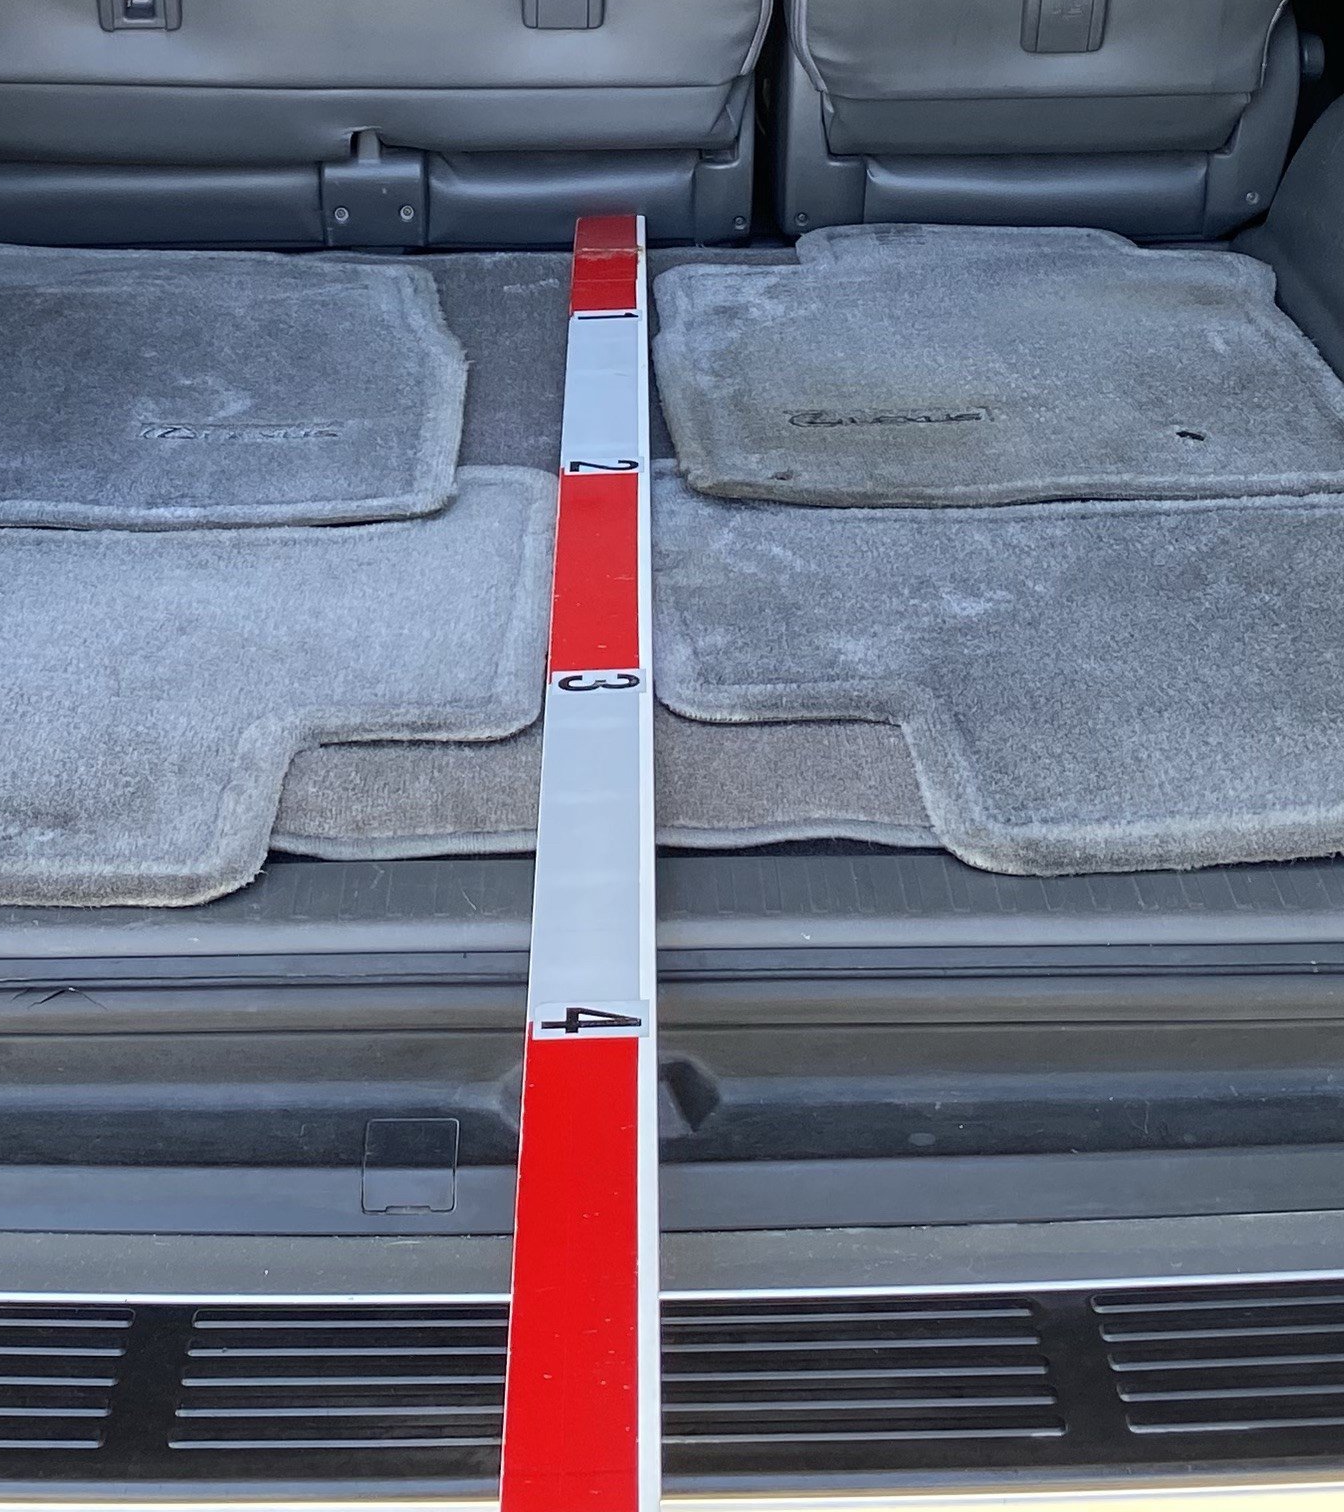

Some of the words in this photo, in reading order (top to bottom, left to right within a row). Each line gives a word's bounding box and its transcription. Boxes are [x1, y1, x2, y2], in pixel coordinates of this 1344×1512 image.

[577, 312, 639, 320] 1
[569, 459, 639, 472] 2
[558, 673, 640, 691] 3
[541, 1007, 642, 1034] 4
